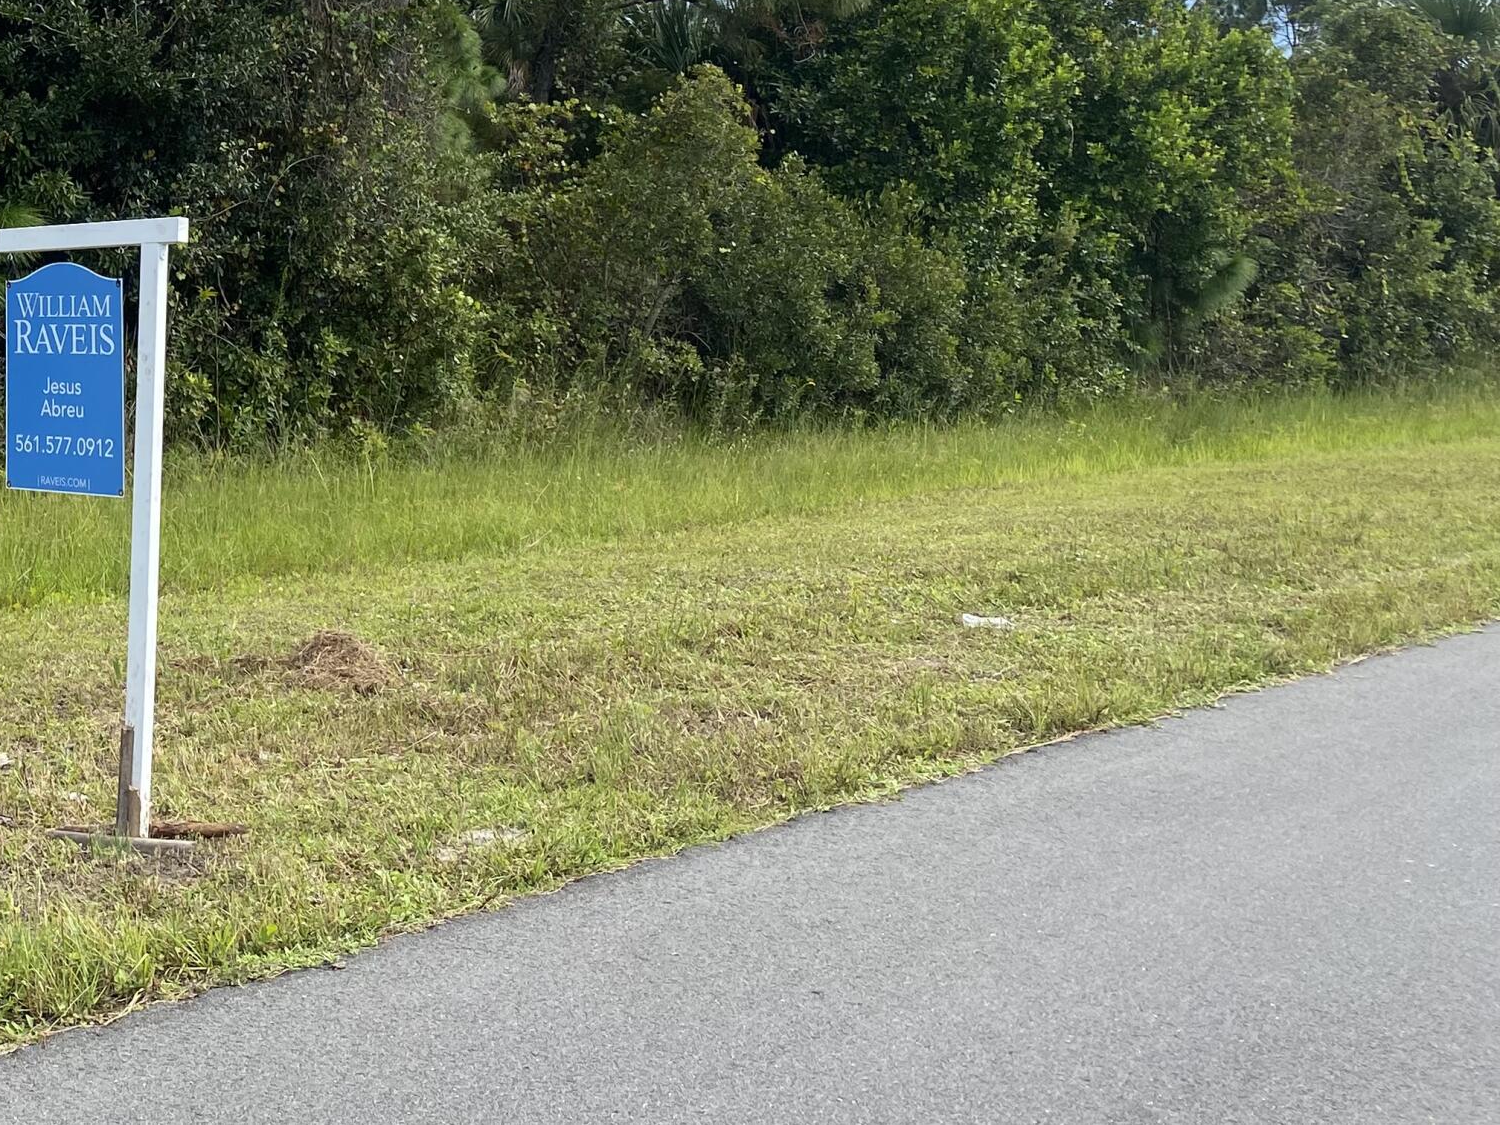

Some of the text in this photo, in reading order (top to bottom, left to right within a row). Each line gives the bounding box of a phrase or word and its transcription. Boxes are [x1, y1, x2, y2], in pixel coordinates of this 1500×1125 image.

[16, 292, 112, 318] WILLIAM
[14, 319, 115, 356] RAVEIS
[42, 377, 82, 395] Jesus
[40, 400, 84, 418] Abreu
[15, 434, 114, 458] 561.577.0912
